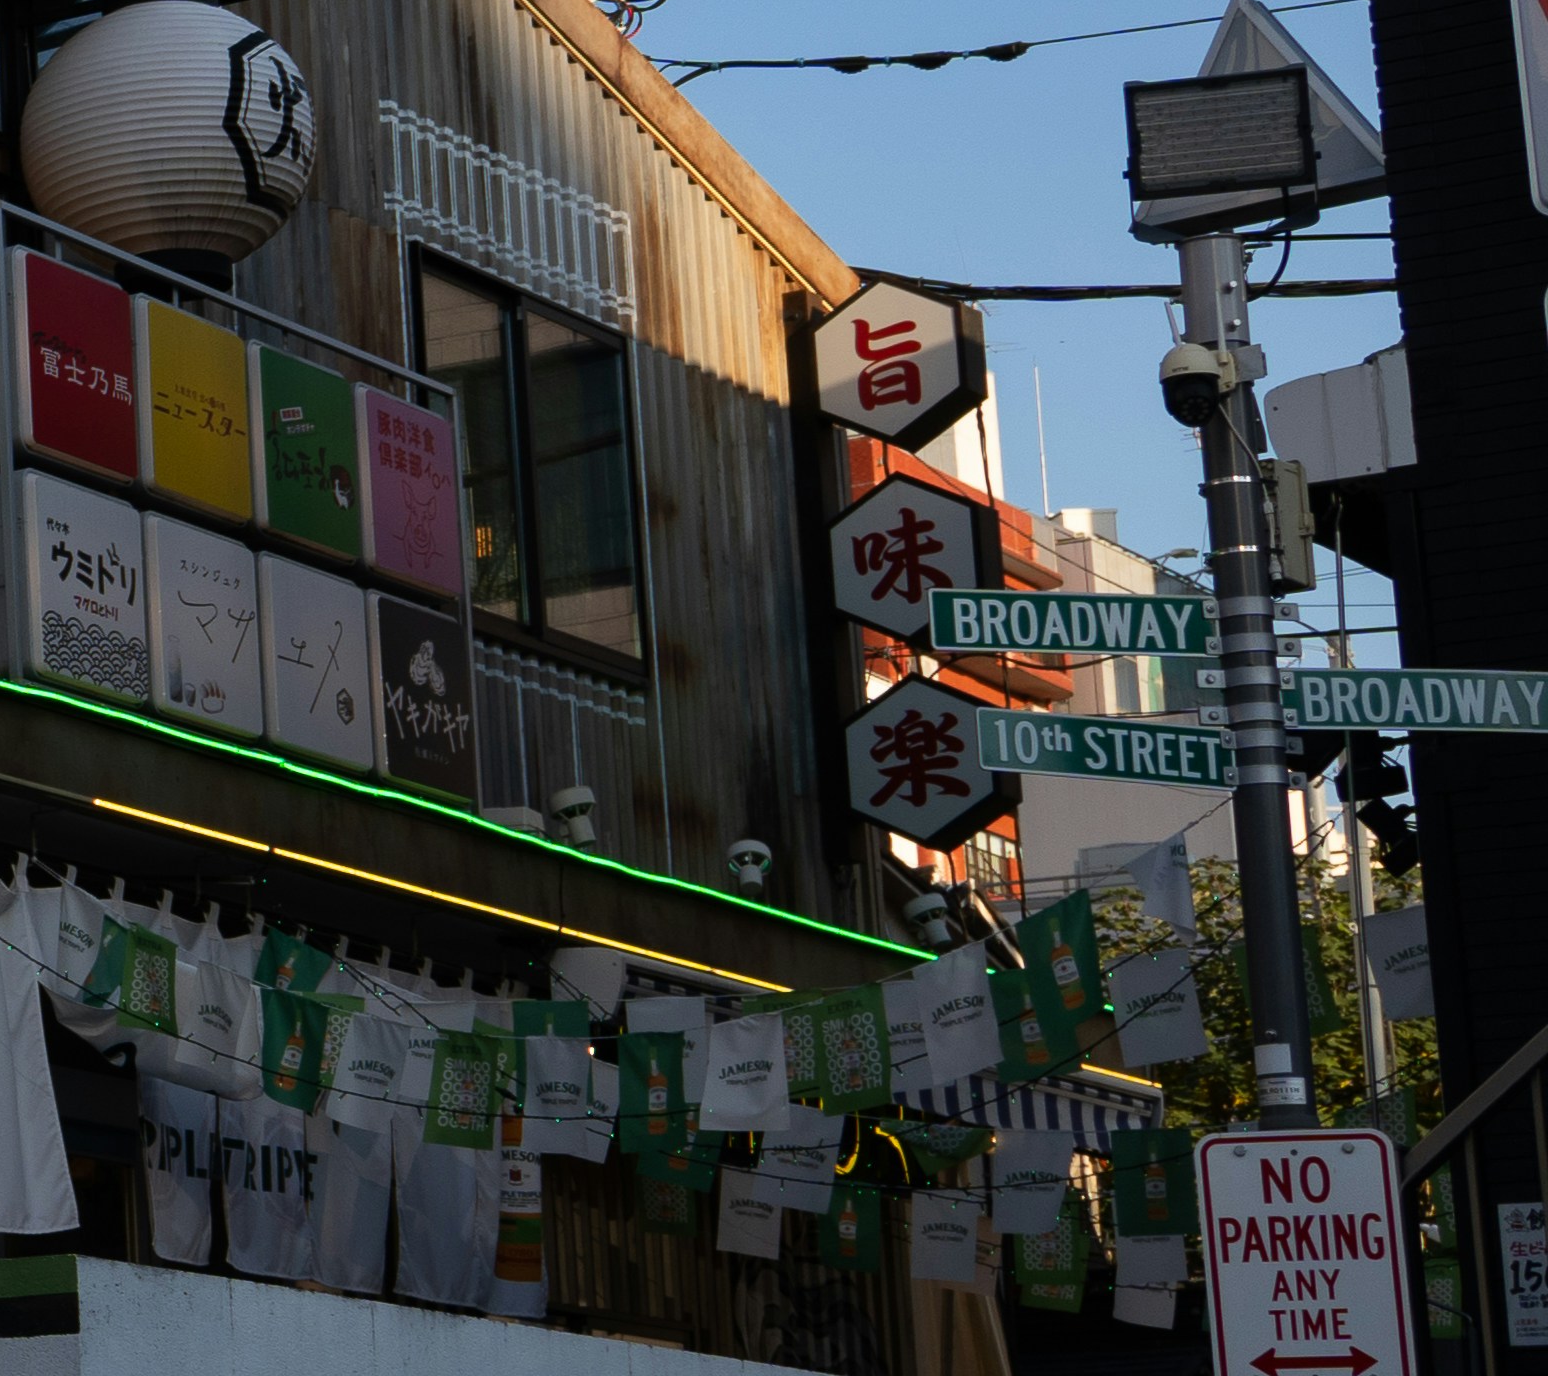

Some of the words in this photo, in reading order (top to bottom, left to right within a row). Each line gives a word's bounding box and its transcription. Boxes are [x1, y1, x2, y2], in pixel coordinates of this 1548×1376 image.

[39, 345, 133, 406] 富士乃馬
[852, 317, 923, 411] 旨
[154, 392, 246, 437] ニュースター
[376, 409, 435, 452] 豚肉洋食
[378, 441, 422, 478] 倶楽部
[45, 517, 70, 537] 代々木
[50, 540, 137, 607] ウミドリ
[851, 507, 953, 604] 味
[73, 595, 119, 622] マグロとトリ
[953, 597, 1194, 650] BROADWAY
[1302, 677, 1546, 727] BROADWAY
[870, 710, 971, 807] 楽
[994, 718, 1073, 766] 10th
[1085, 725, 1222, 781] STREET
[827, 999, 863, 1014] EXTRA
[931, 995, 985, 1024] JAMESON
[1125, 991, 1186, 1014] JAMESON
[348, 1060, 396, 1080] JAMESON
[719, 1059, 773, 1080] JAMESON
[535, 1081, 582, 1097] JAMESON
[1260, 1156, 1330, 1204] NO
[728, 1198, 774, 1215] JAMESON
[921, 1222, 968, 1237] JAMESON
[1218, 1213, 1385, 1264] PARKING
[1271, 1268, 1341, 1302] ANY
[1268, 1308, 1352, 1341] TIME
